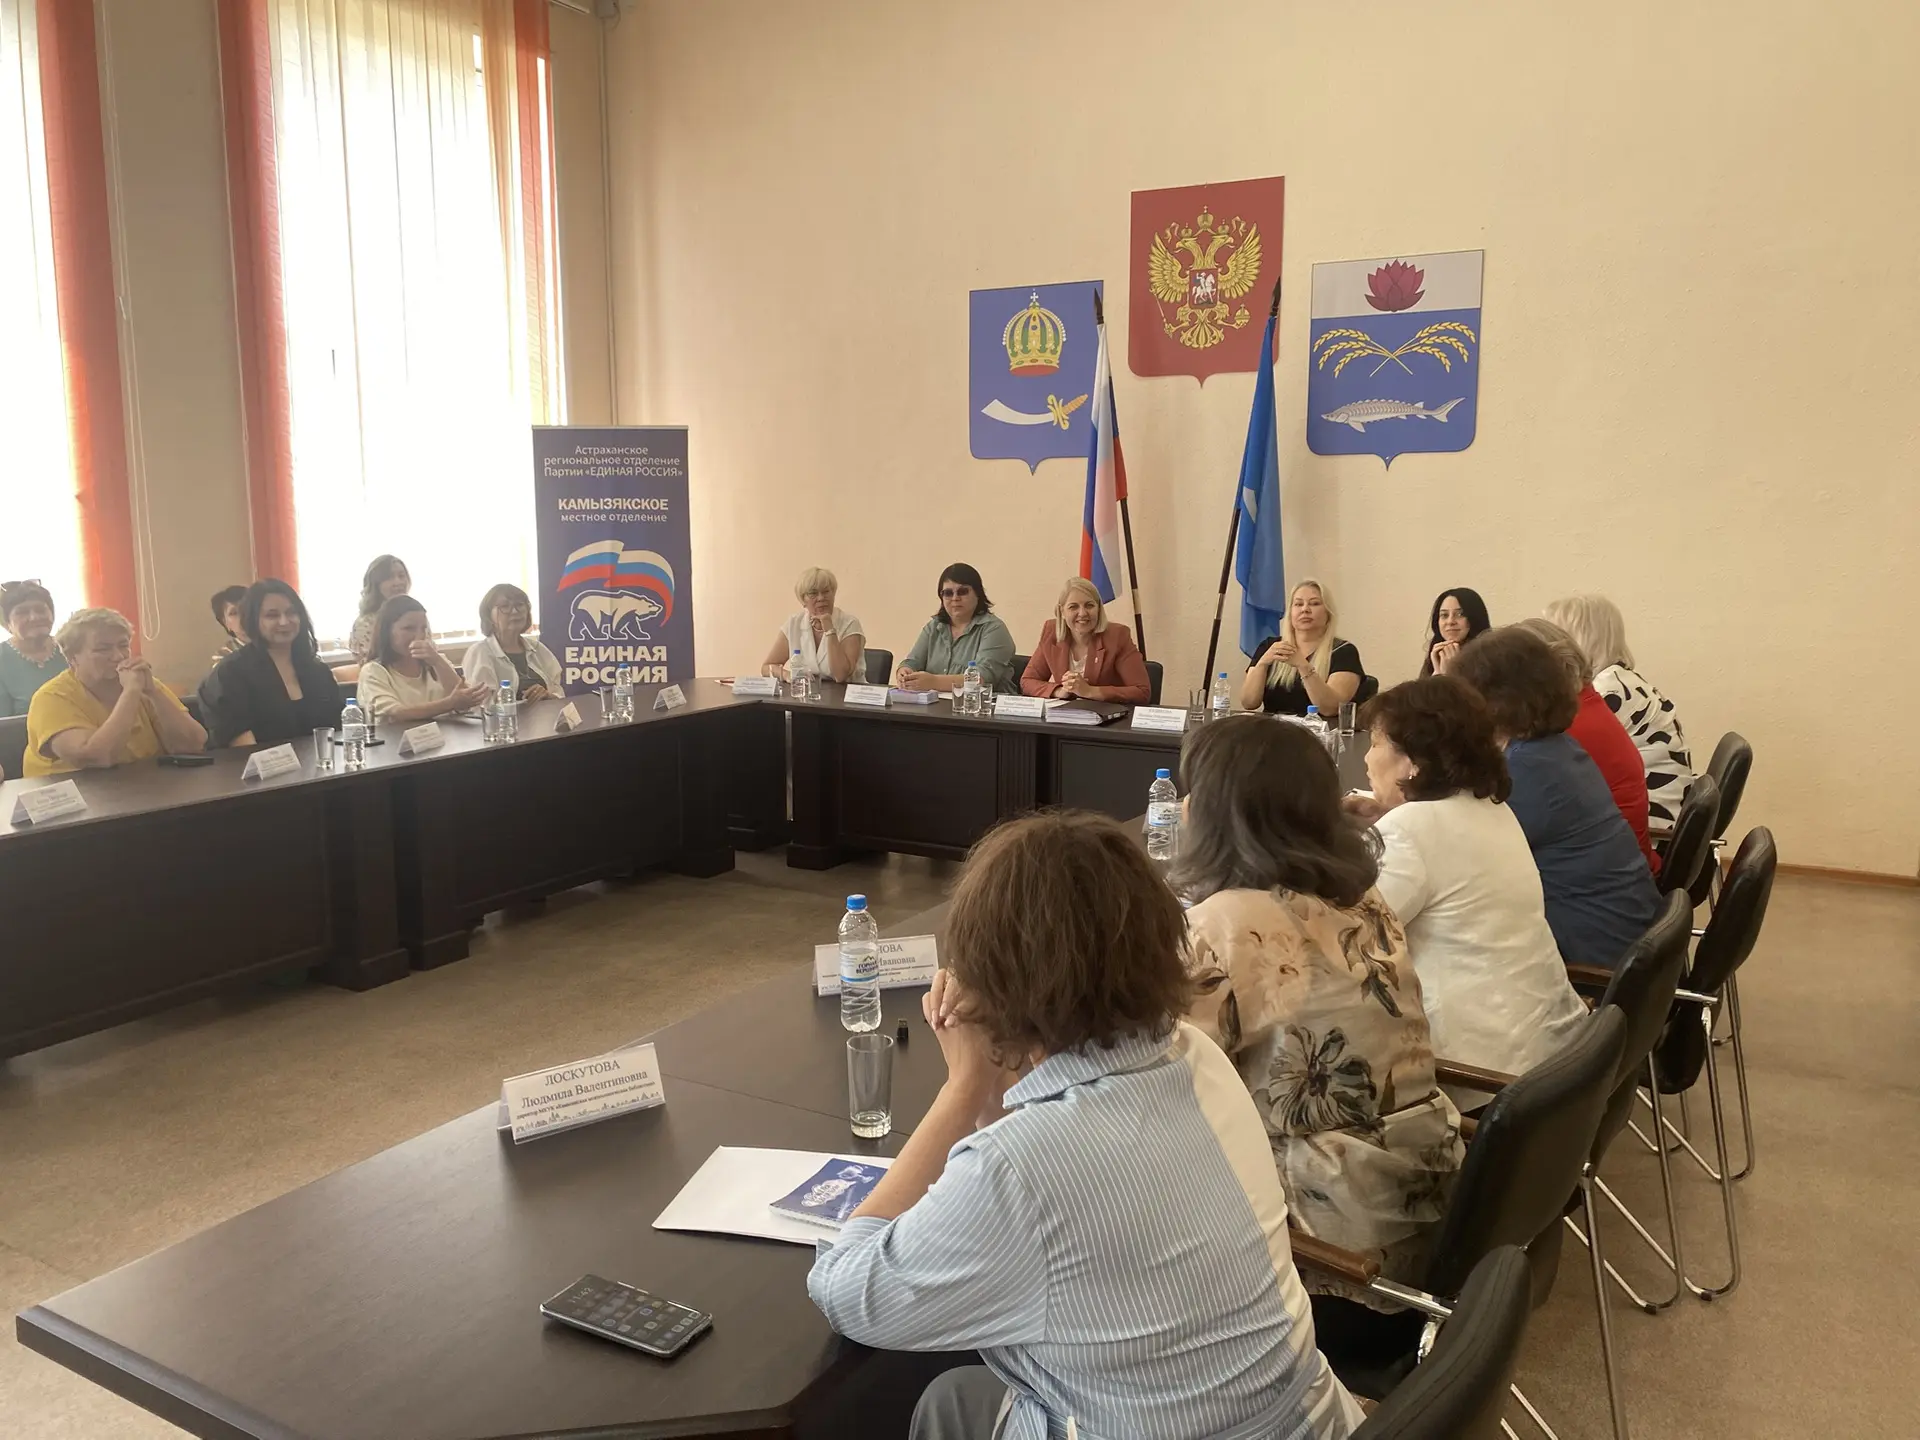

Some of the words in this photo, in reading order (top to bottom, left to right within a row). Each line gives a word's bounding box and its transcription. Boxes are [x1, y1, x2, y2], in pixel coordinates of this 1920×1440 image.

[575, 445, 648, 456] Астраханское
[544, 456, 621, 467] региональное
[623, 456, 680, 466] отделение
[544, 467, 584, 478] Партии
[585, 466, 633, 477] «ЕДИНАЯ
[635, 466, 683, 477] РОССИЯ»
[558, 498, 669, 511] КАМЫЗЯКСКОЕ
[561, 514, 607, 523] местное
[608, 513, 668, 523] отделение
[565, 645, 668, 664] ЕДИНАЯ
[545, 1060, 621, 1086] ЛОСКУТОВА
[522, 1090, 573, 1109] Людмила
[576, 1071, 648, 1095] Валентиновна
